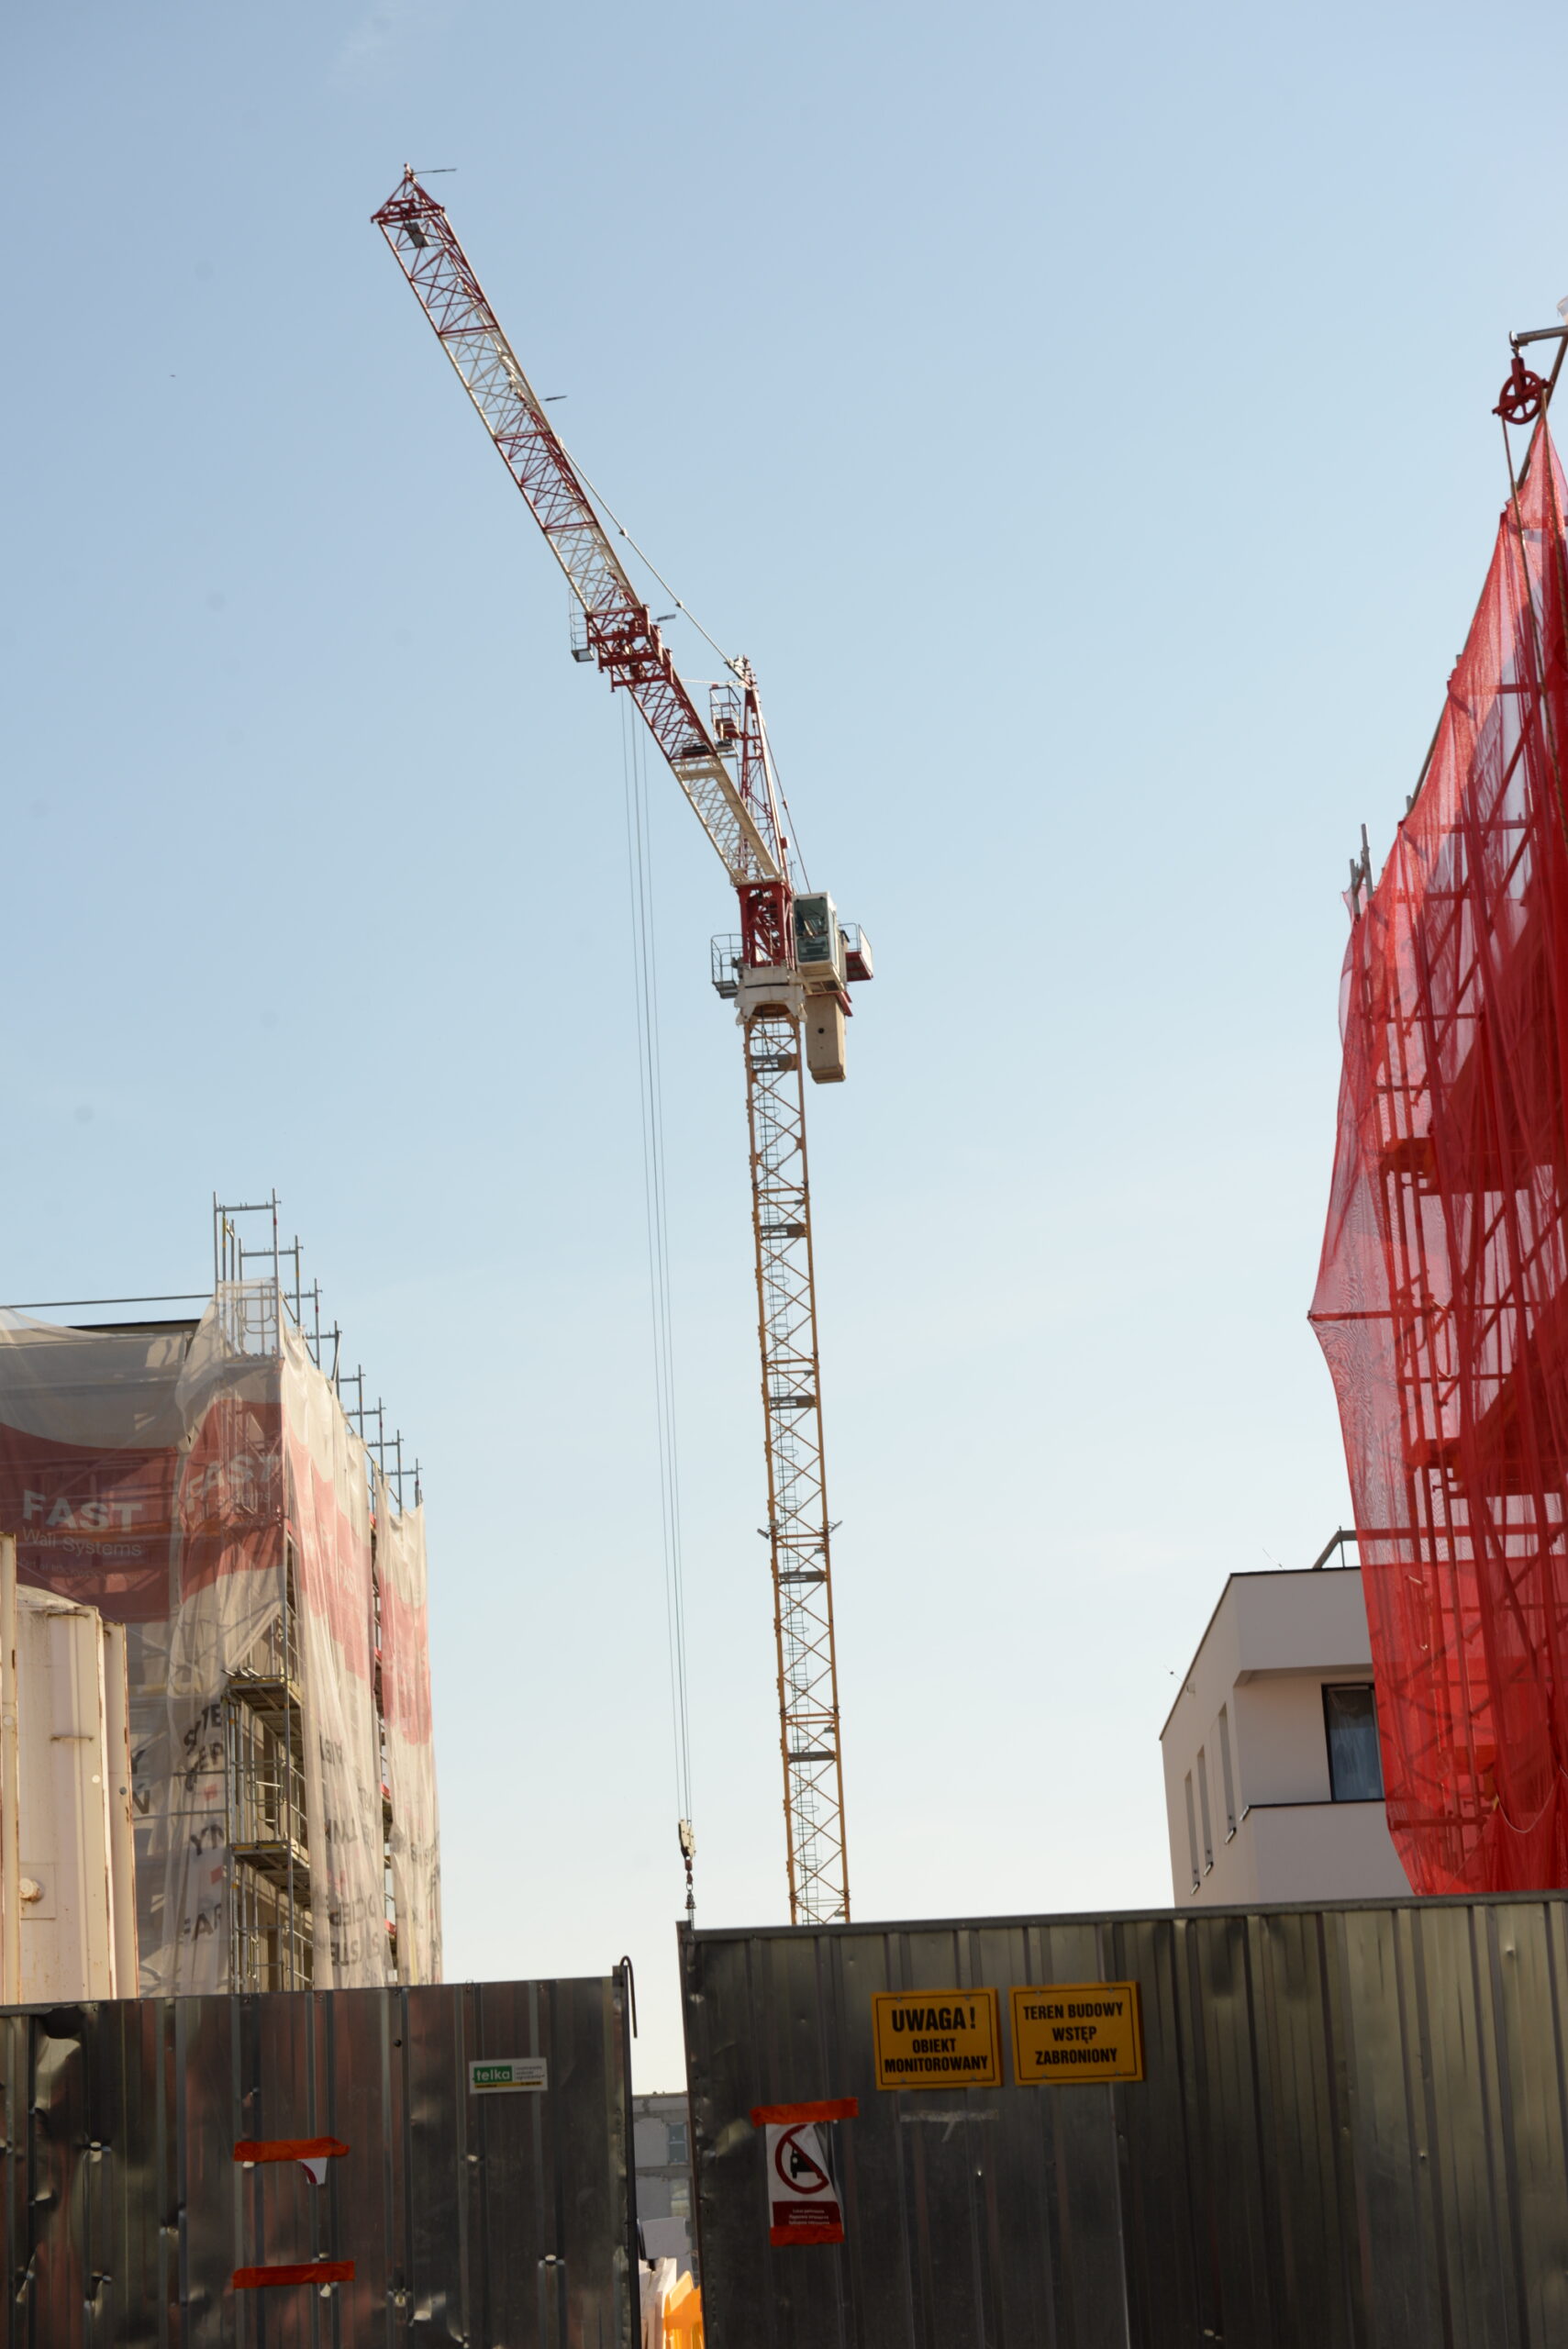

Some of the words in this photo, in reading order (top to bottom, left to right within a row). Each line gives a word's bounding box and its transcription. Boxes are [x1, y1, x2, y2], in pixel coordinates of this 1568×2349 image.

[22, 1489, 143, 1533] FAST
[22, 1526, 56, 1548] Wall
[62, 1536, 142, 1557] Systems
[1023, 2004, 1064, 2021] TEREN
[1067, 2001, 1123, 2019] BUDOWY
[1051, 2026, 1097, 2044] WSTĘP
[912, 2038, 956, 2054] OBIEKT
[884, 2055, 988, 2074] MONITOROWANY
[1035, 2047, 1118, 2065] ZABRONIONY
[476, 2069, 510, 2082] telka
